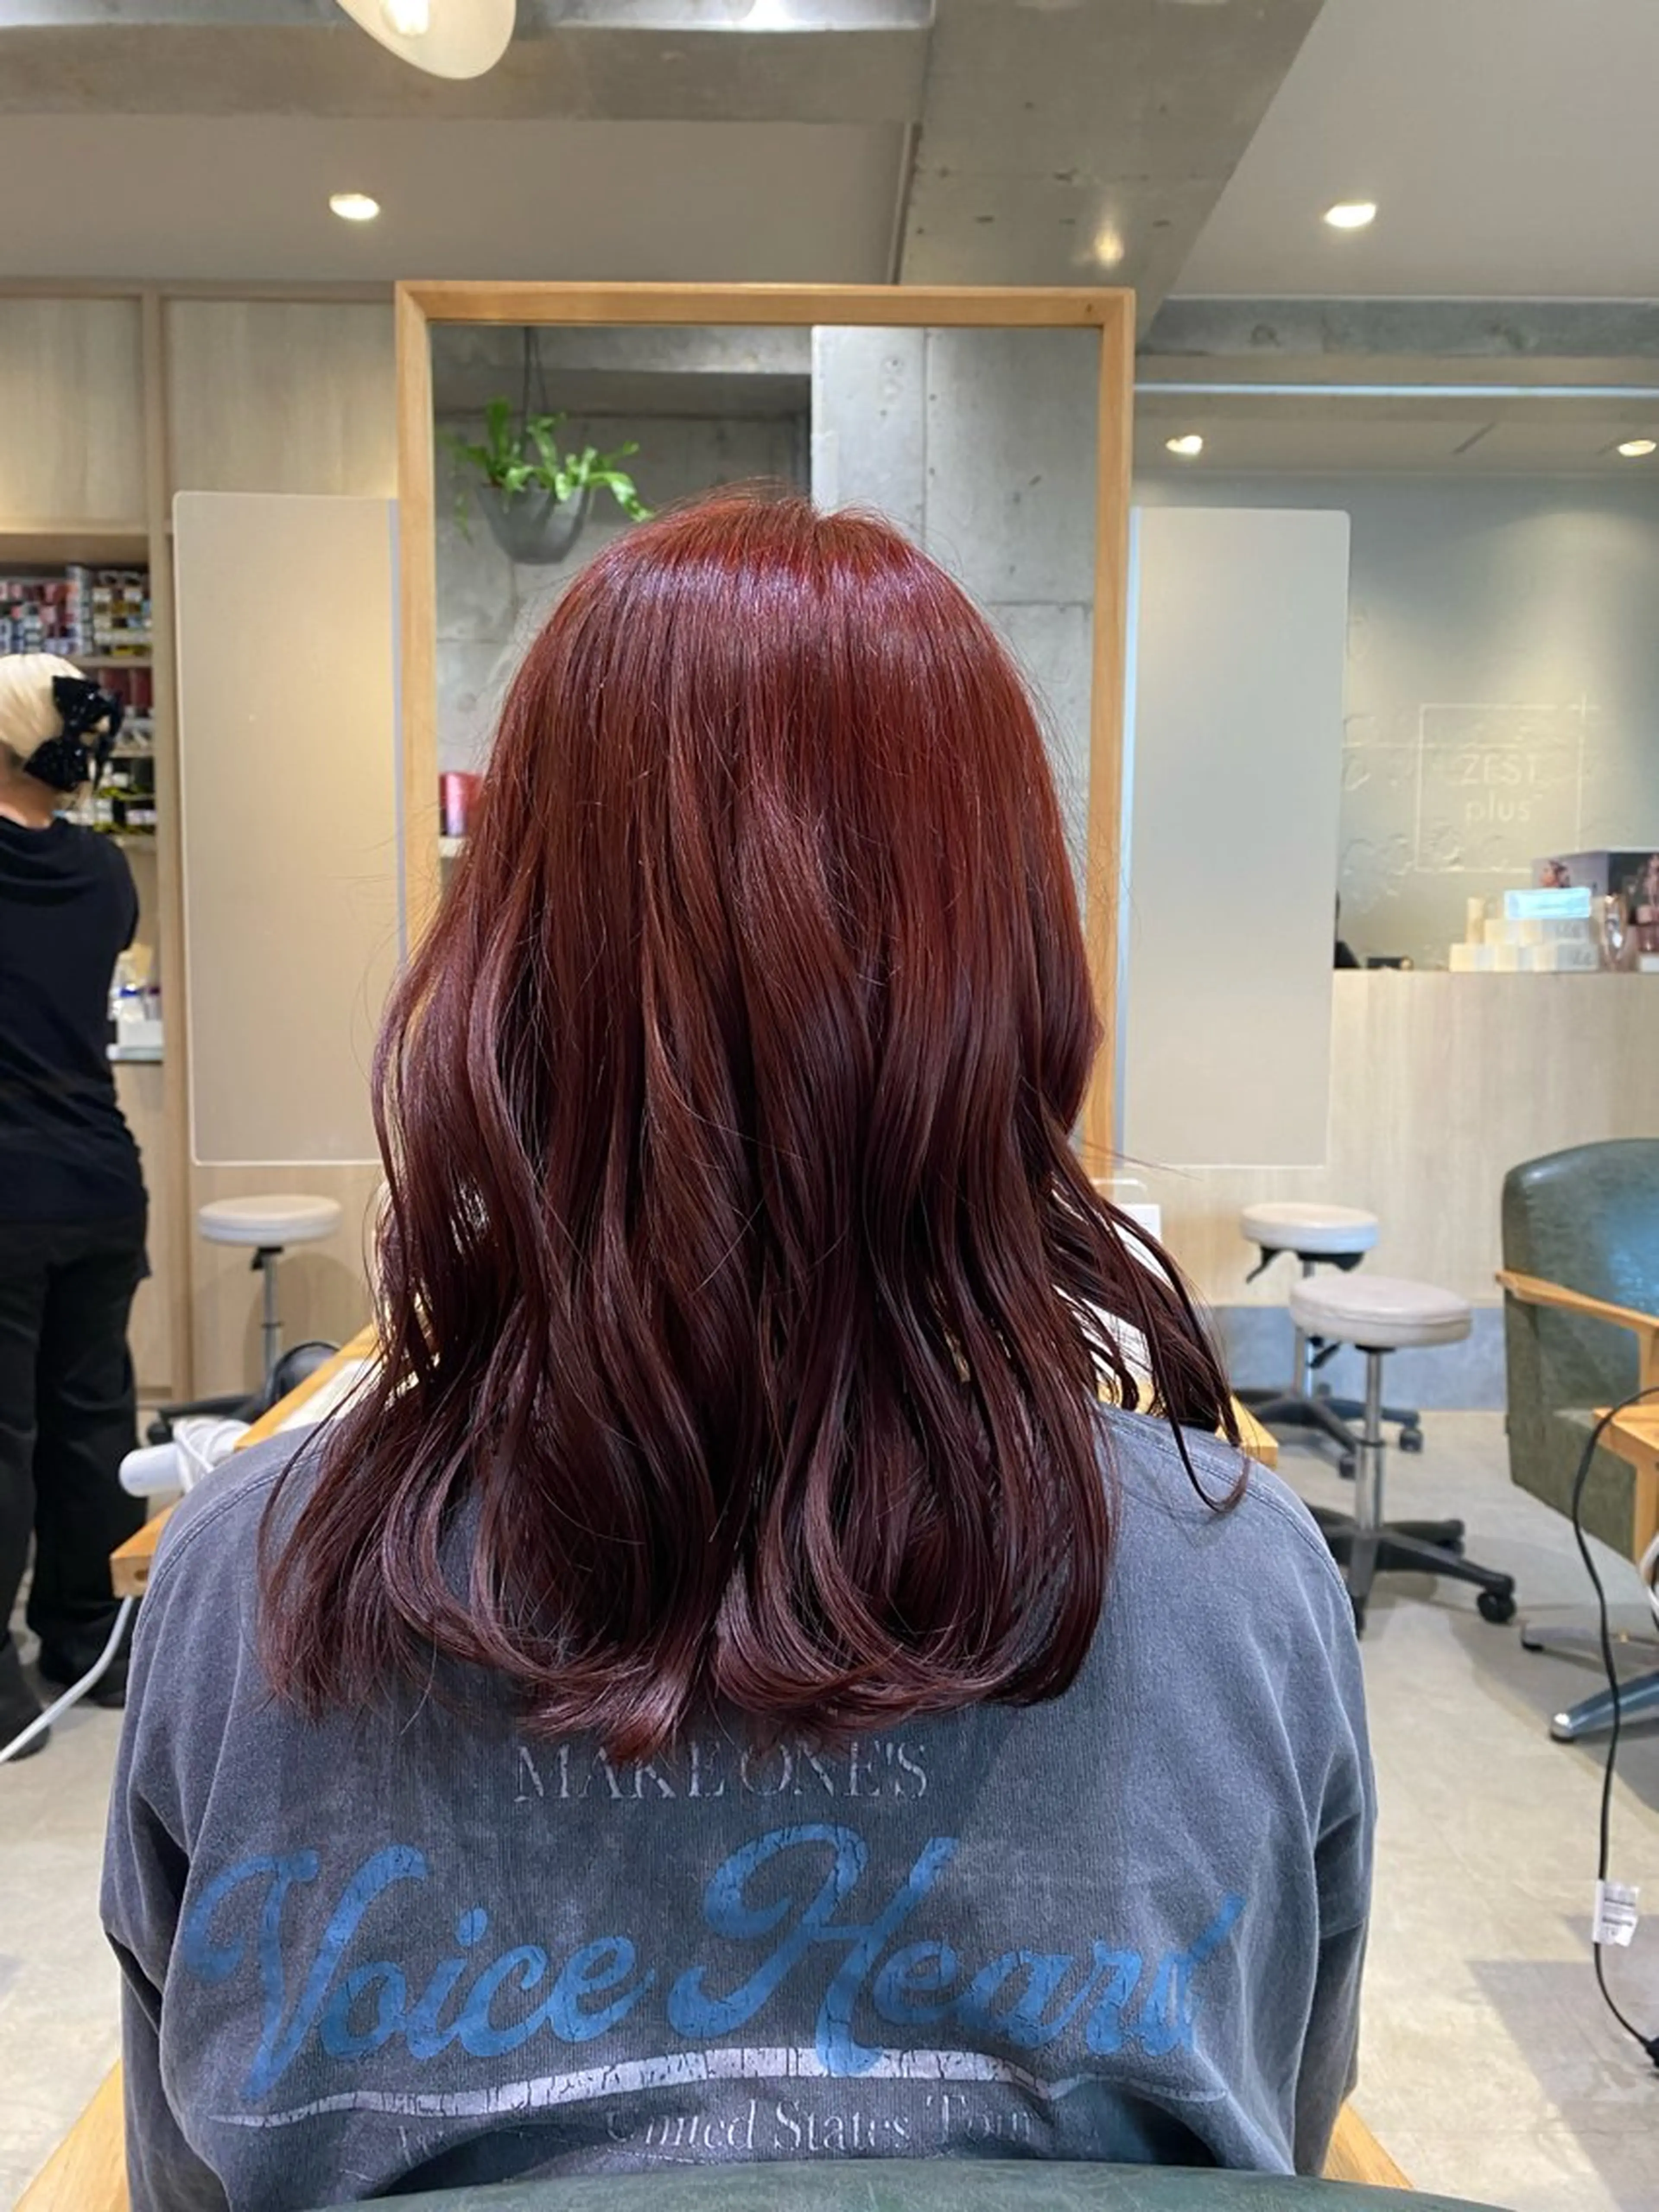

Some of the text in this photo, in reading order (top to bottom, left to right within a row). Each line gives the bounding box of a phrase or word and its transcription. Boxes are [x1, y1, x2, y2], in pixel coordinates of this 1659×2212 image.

[1465, 789, 1532, 827] plus
[183, 1843, 655, 2102] Voice
[774, 2097, 910, 2151] States
